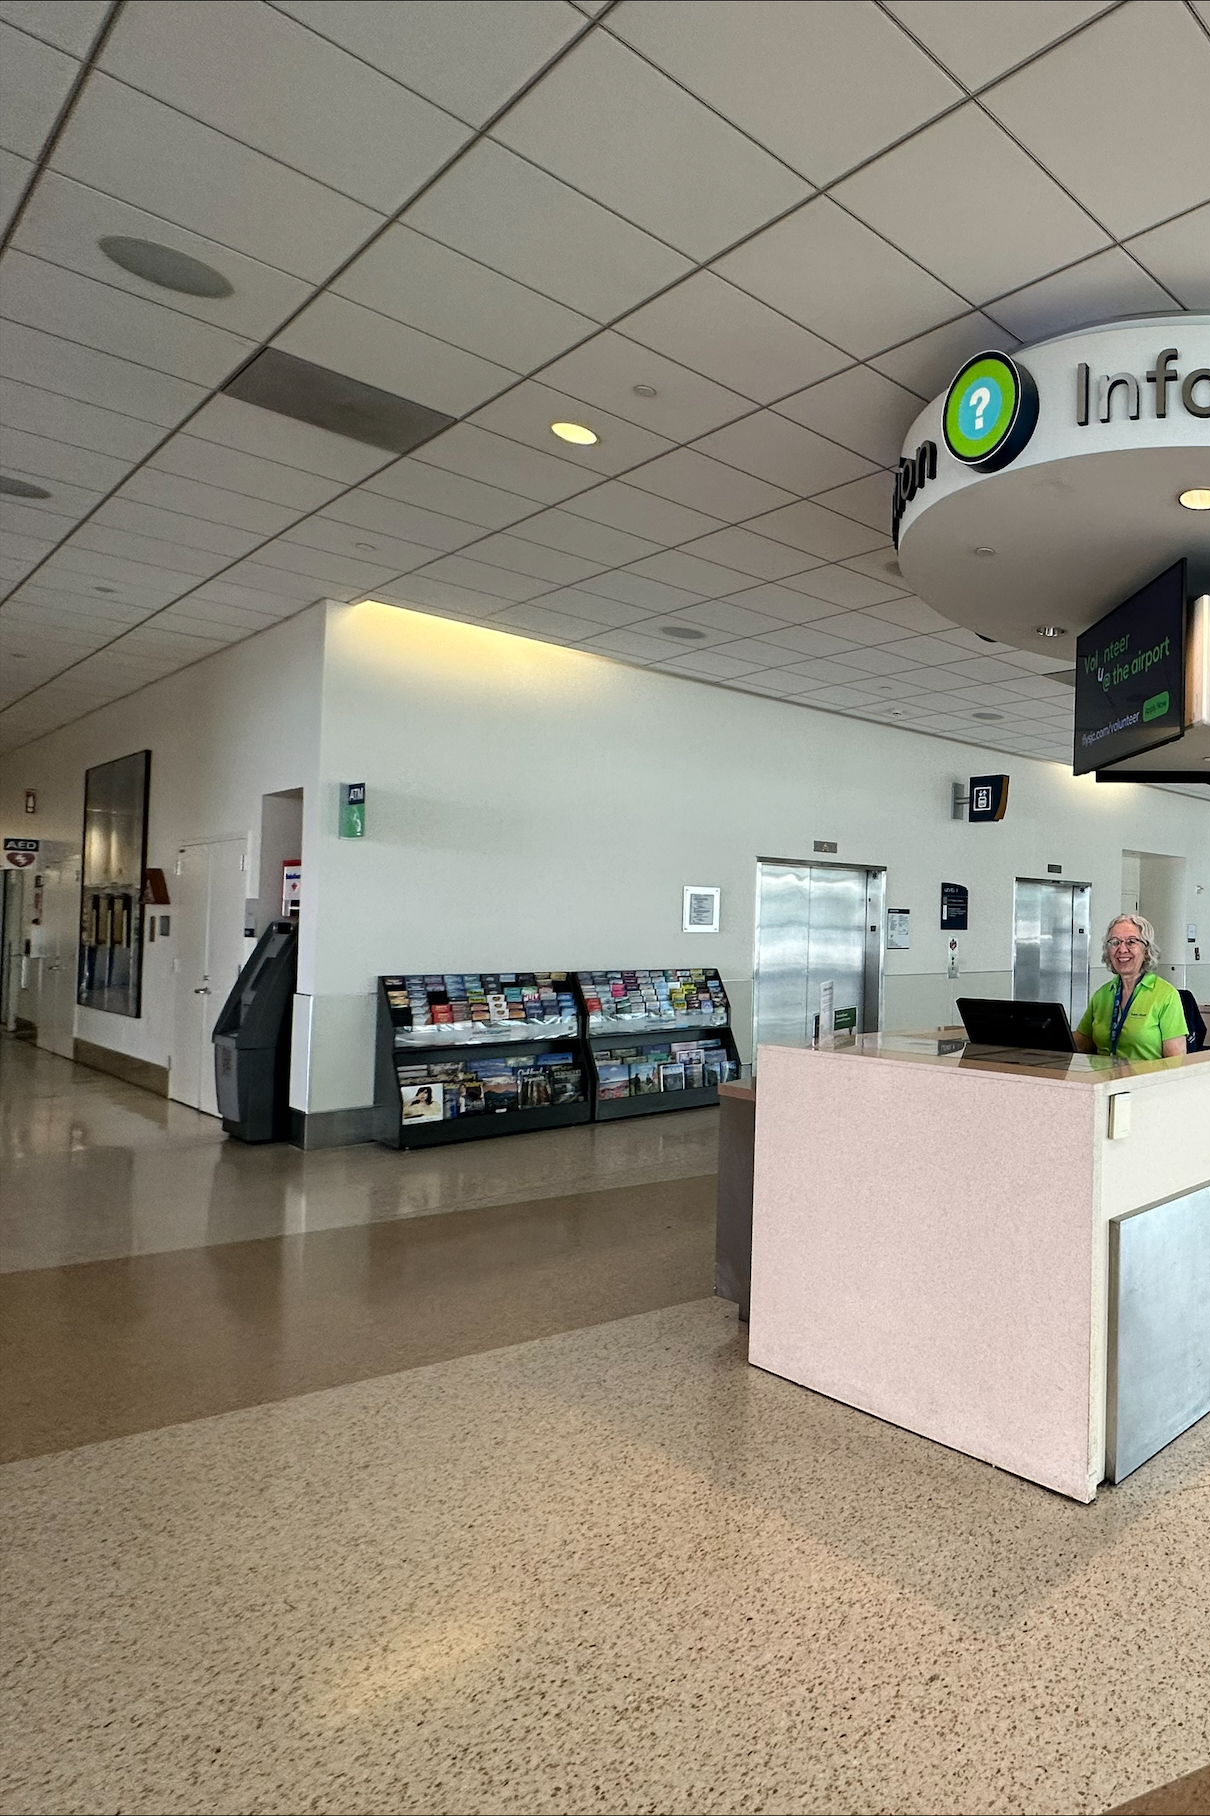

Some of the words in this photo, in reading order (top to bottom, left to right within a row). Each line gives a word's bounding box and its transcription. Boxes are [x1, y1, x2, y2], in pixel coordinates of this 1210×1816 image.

[969, 387, 991, 430] ?
[1102, 673, 1112, 693] @
[1112, 663, 1130, 686] the
[1131, 636, 1170, 676] airport
[349, 786, 364, 801] ATM
[6, 840, 37, 850] AED
